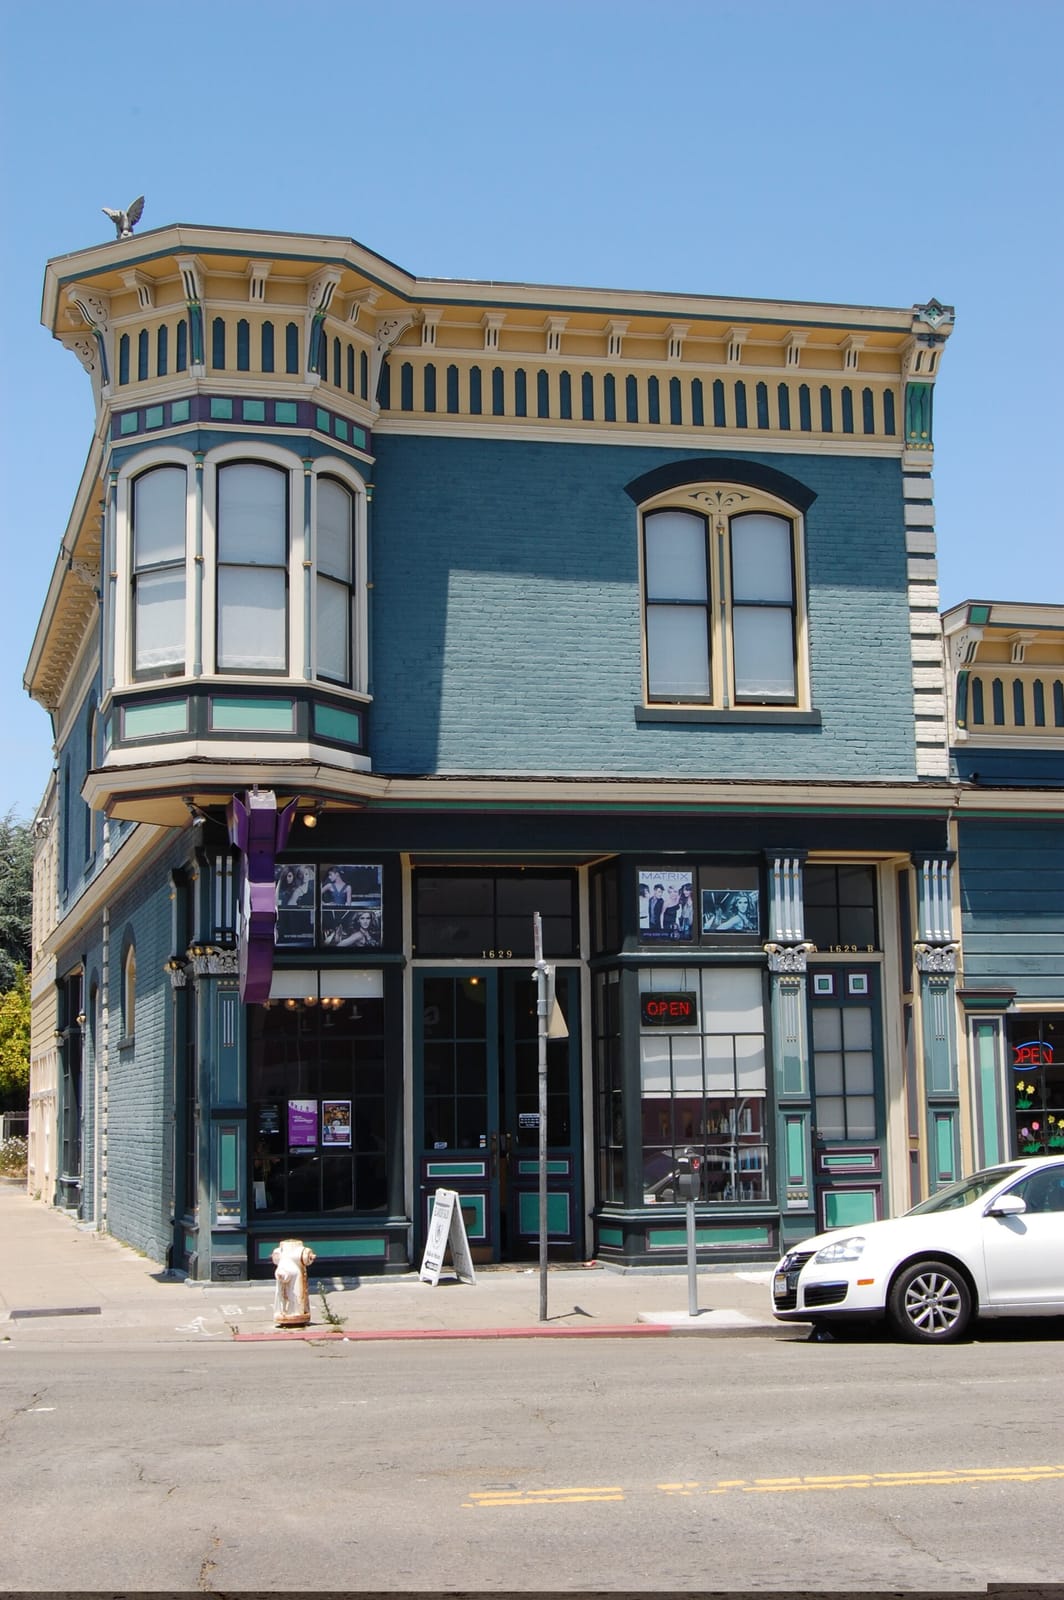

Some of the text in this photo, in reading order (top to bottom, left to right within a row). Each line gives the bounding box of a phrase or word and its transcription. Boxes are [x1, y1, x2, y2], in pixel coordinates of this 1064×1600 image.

[641, 872, 689, 880] MATRIX
[829, 944, 857, 953] 1629
[866, 944, 874, 953] B
[482, 950, 512, 959] 1629
[647, 1001, 689, 1016] OPEN
